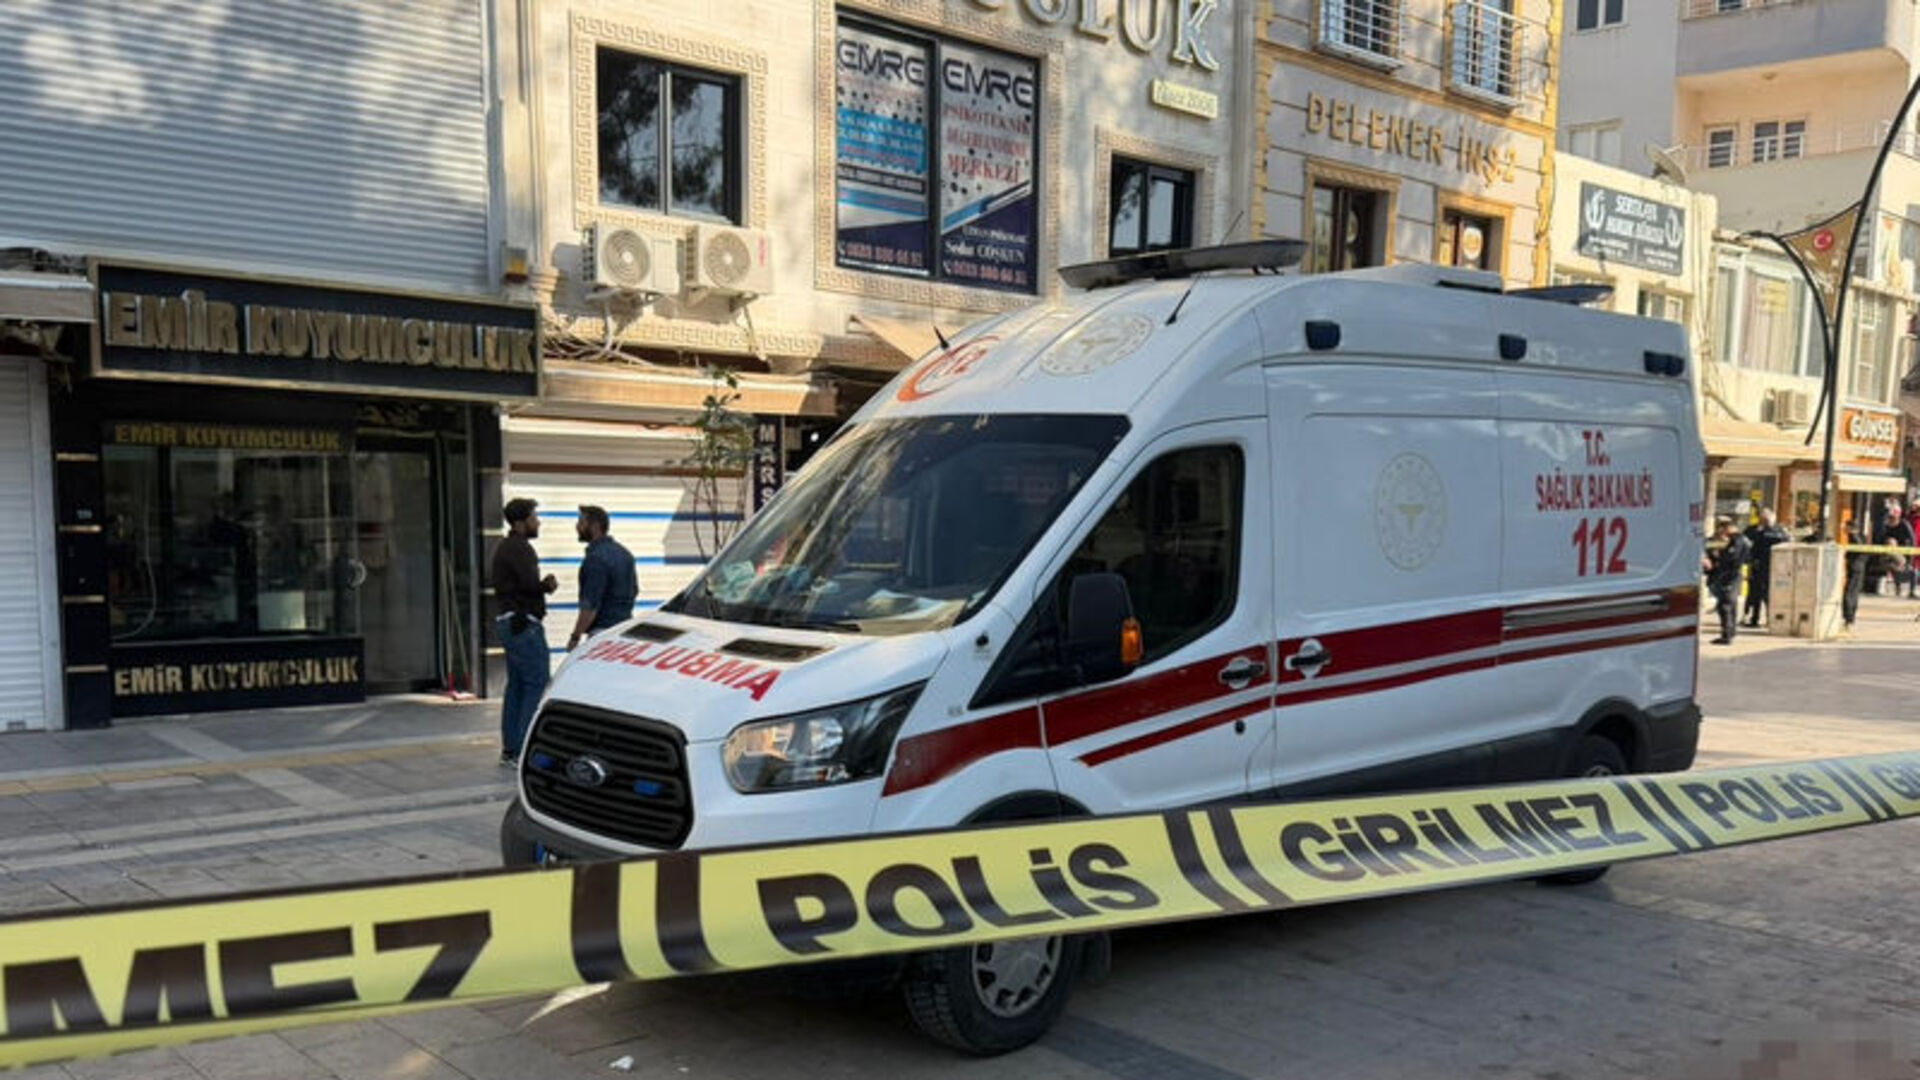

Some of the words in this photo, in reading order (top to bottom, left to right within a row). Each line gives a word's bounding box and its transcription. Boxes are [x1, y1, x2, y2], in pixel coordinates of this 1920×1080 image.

[838, 39, 925, 87] EMRE
[943, 58, 1033, 109] EMRE
[1306, 90, 1444, 166] DELENER
[103, 289, 239, 353] EMİR
[244, 305, 537, 373] KUYUMCULUK
[115, 423, 177, 445] EMİR
[185, 425, 341, 450] KUYUMCULUK
[1582, 429, 1611, 466] T.C.
[1536, 466, 1586, 512] SAĞLIK
[1588, 466, 1653, 510] BAKANLIĞI
[1572, 515, 1628, 577] 112
[114, 663, 184, 696] EMİR
[190, 656, 359, 692] KUYUMCULUK
[756, 842, 1161, 955] POLİS
[1279, 792, 1649, 882] GİRİLMEZ
[1678, 772, 1844, 829] POLİS
